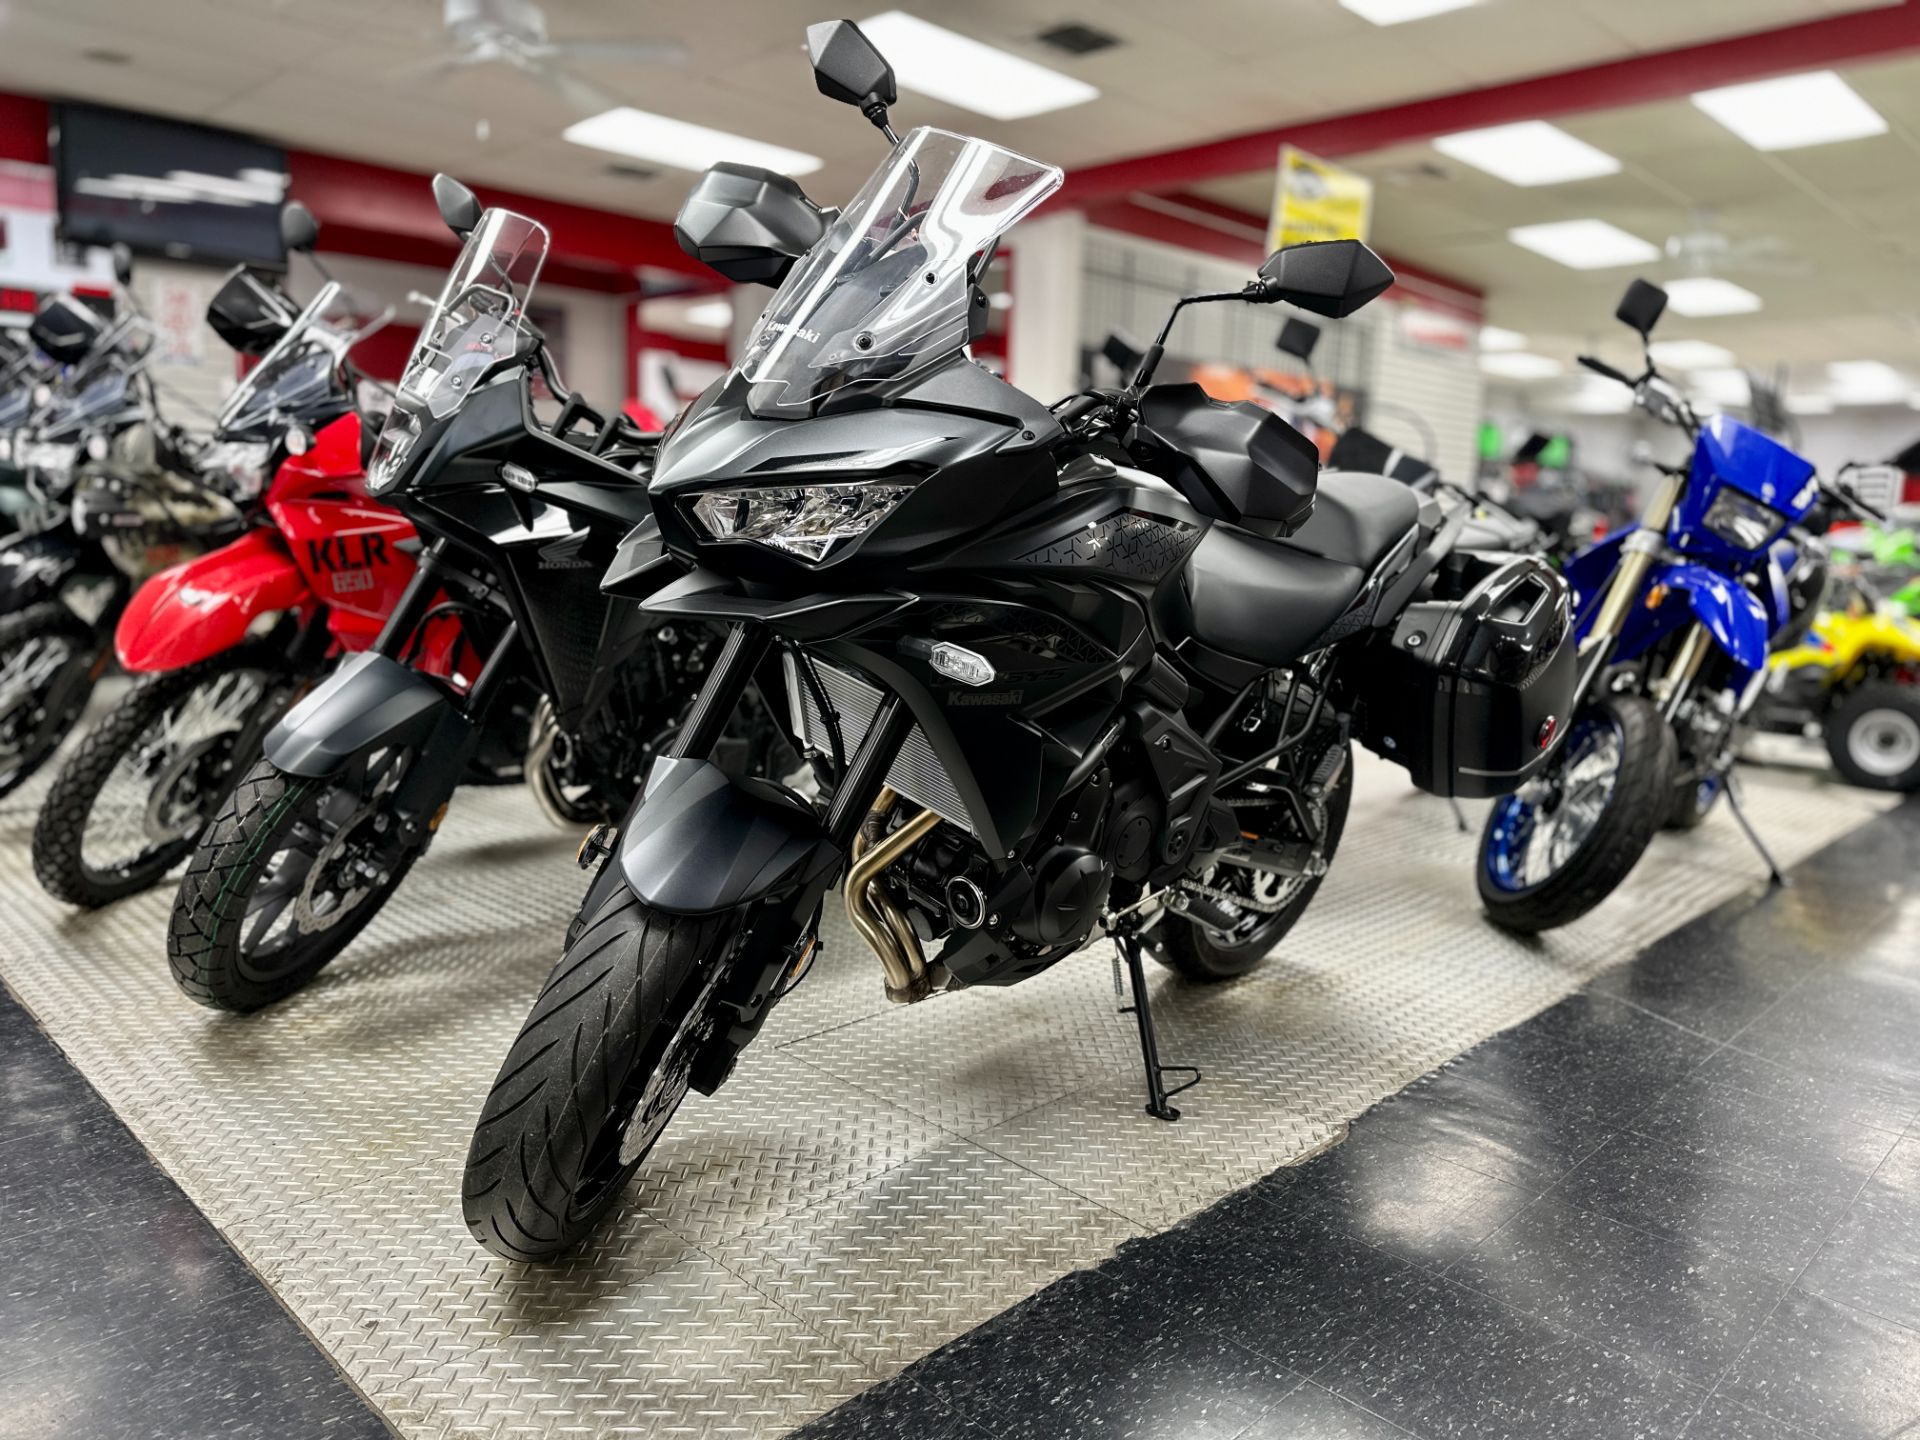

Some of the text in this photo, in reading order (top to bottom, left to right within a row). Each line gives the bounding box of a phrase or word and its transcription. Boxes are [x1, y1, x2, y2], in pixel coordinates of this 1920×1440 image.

[764, 320, 821, 344] Kawsaki
[308, 532, 389, 574] KLR
[537, 556, 593, 570] HONDA
[332, 568, 374, 593] 650
[947, 690, 1024, 706] Kawasaki
